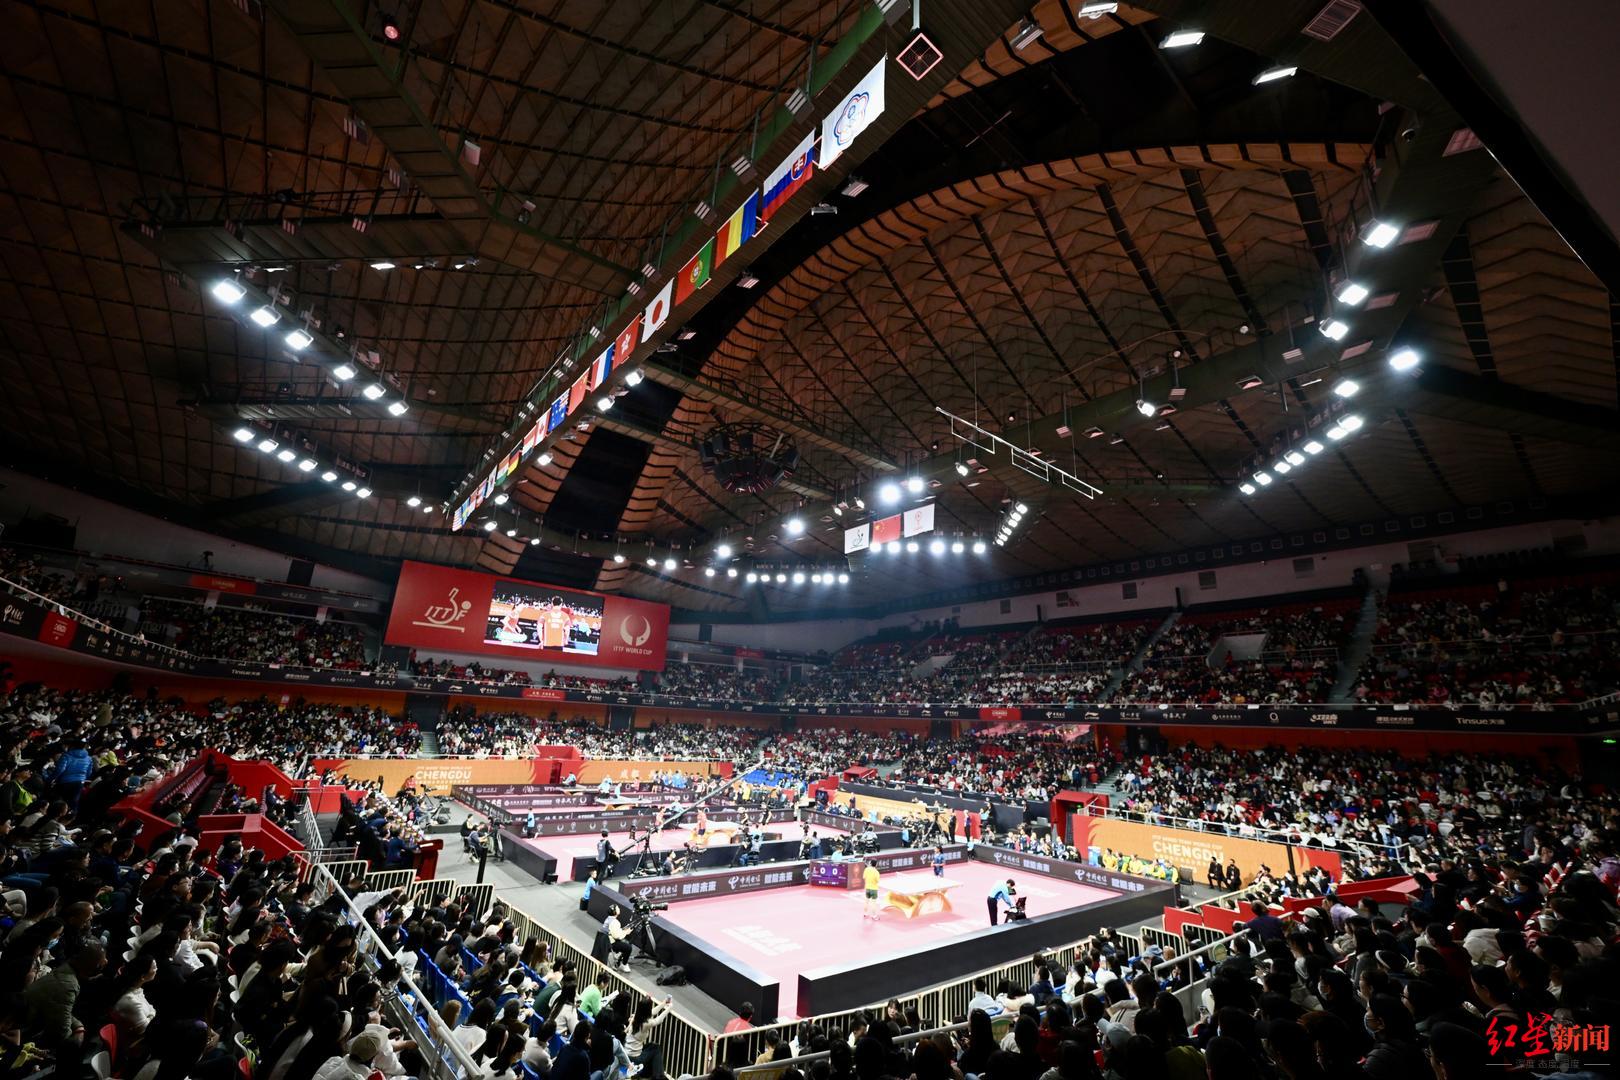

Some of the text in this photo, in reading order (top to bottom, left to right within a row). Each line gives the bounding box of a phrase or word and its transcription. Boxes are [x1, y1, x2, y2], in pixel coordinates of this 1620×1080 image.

[424, 605, 468, 621] ITTF
[415, 770, 472, 780] CHENGDU
[1152, 841, 1224, 864] CHENGDU
